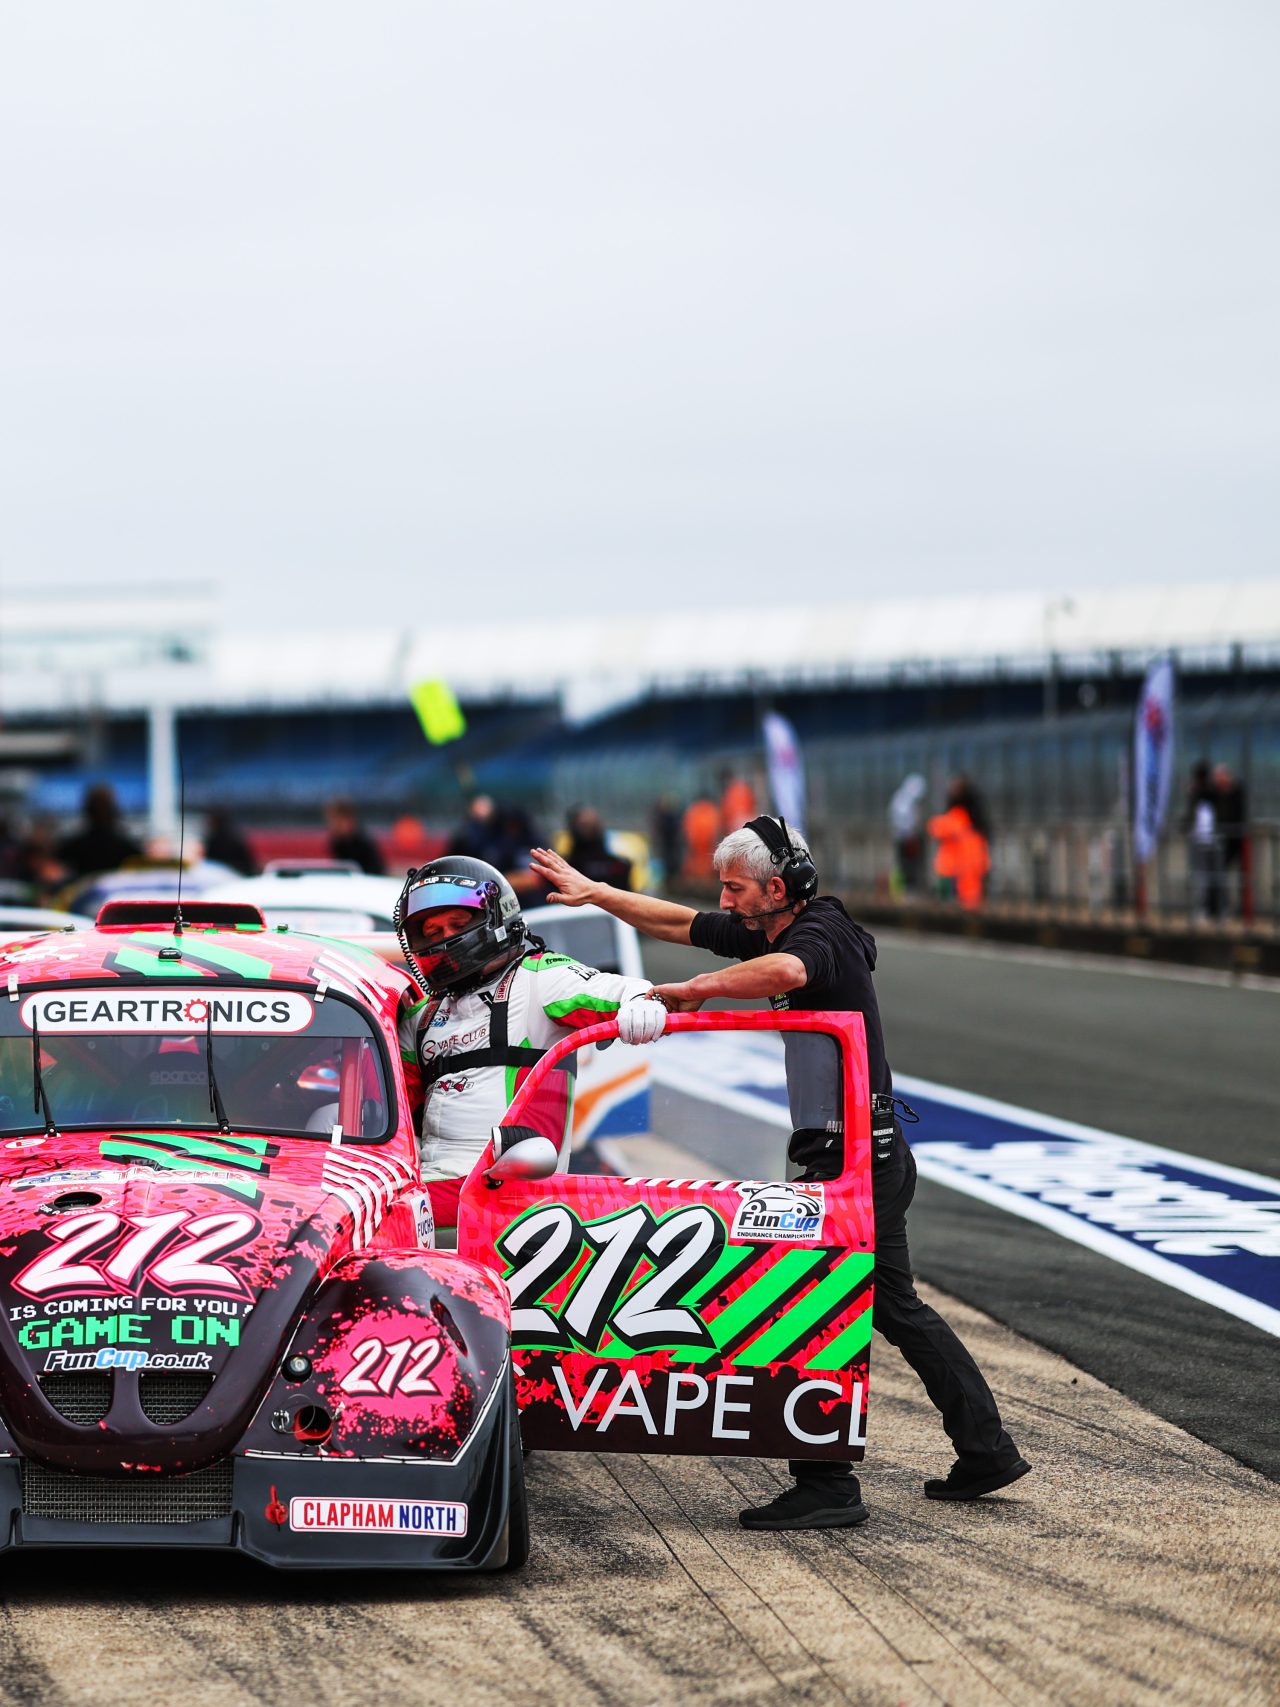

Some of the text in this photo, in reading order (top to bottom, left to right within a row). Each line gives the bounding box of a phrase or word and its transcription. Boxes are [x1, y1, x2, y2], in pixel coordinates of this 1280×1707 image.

[43, 998, 291, 1024] GEARTRONICS
[739, 1212, 819, 1231] FunCup
[16, 1209, 258, 1297] 212
[502, 1205, 716, 1339] 212
[10, 1304, 37, 1321] IS
[44, 1295, 134, 1315] COMING
[141, 1297, 186, 1312] FOR
[19, 1314, 240, 1350] GAME ON
[44, 1348, 213, 1371] FunCup.co.uk
[340, 1336, 443, 1398] 212
[552, 1365, 754, 1440] VAPE
[303, 1502, 457, 1531] CLAPHAM NORTH
